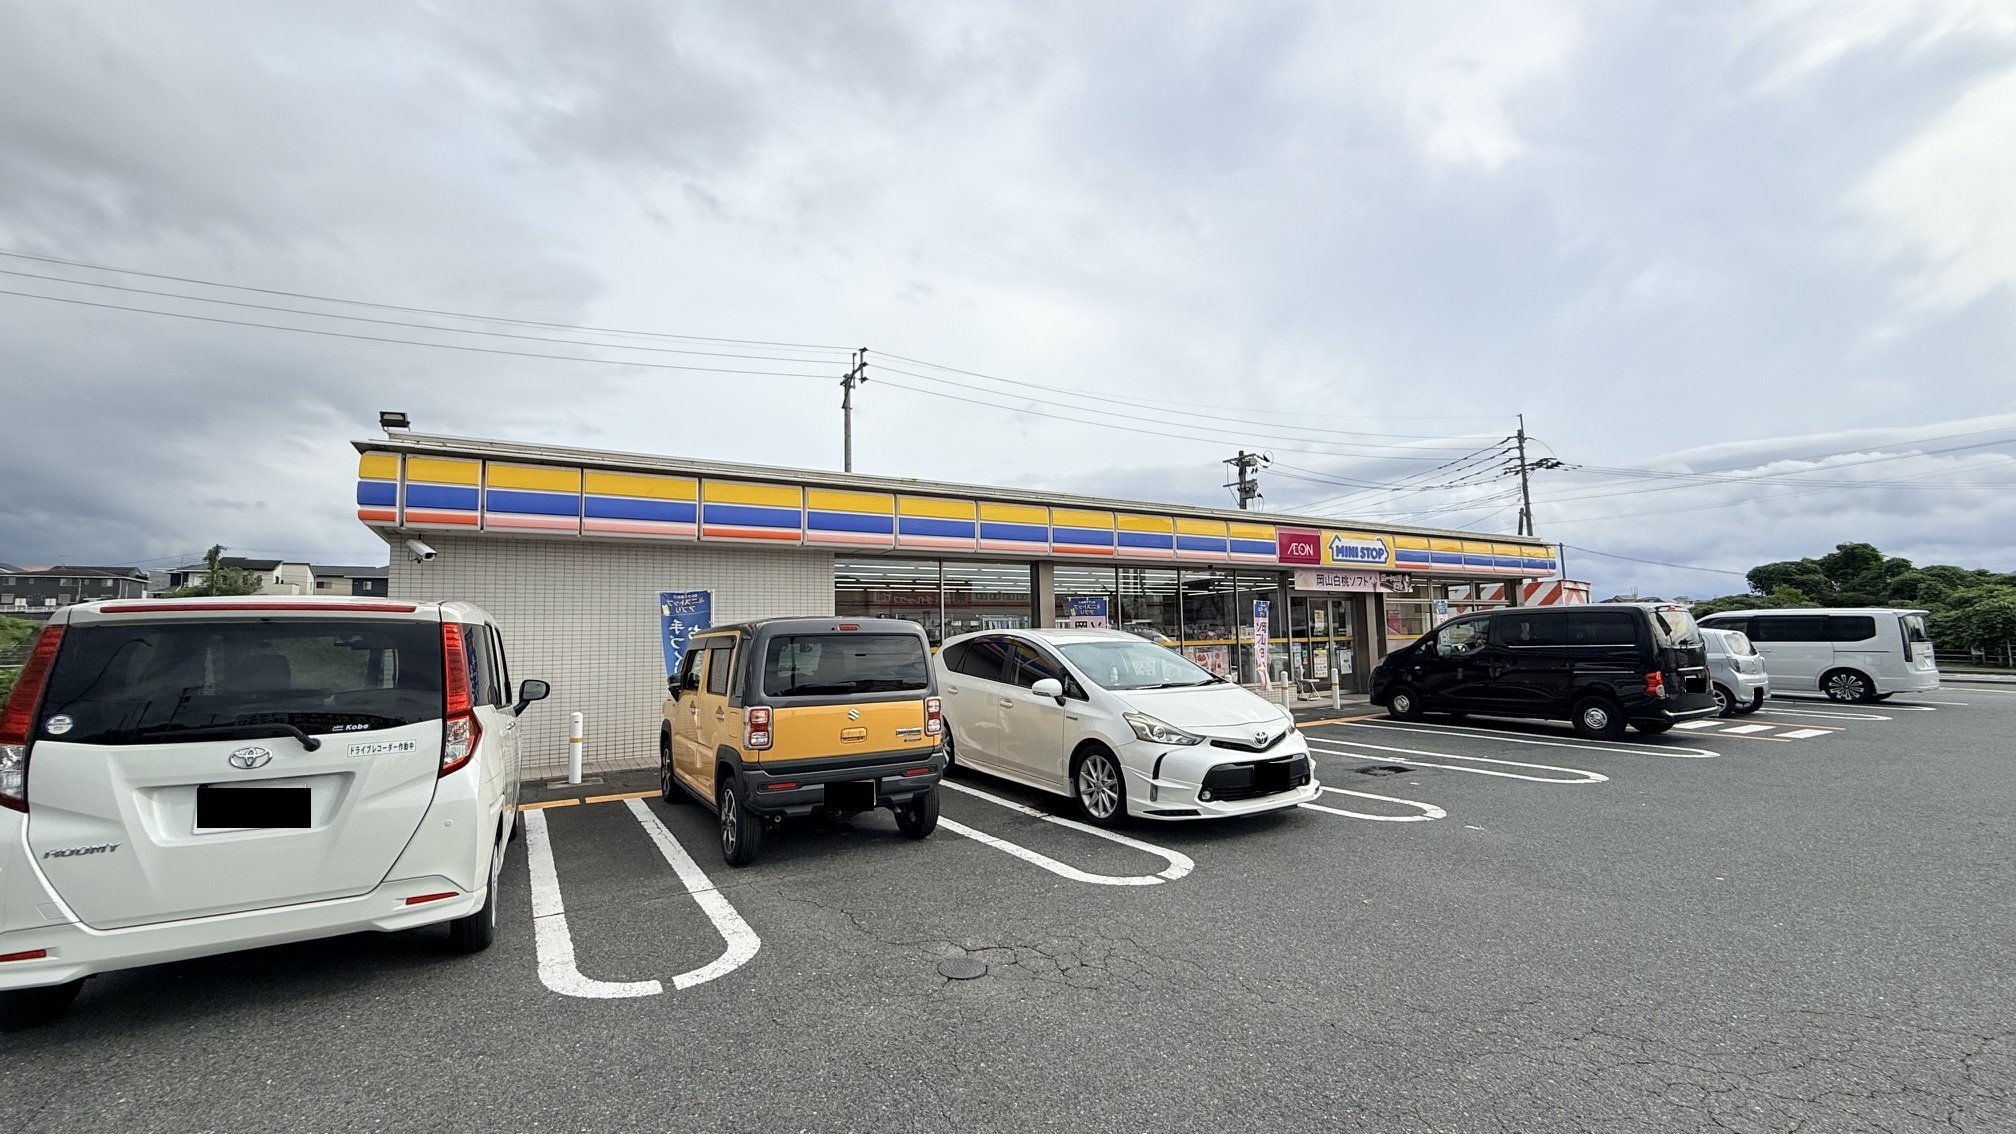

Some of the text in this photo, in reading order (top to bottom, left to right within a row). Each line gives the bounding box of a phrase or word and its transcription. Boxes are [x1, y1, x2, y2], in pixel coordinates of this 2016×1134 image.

[1335, 545, 1384, 560] MINI STOP
[1316, 573, 1369, 588] 岡山白桃ソフト
